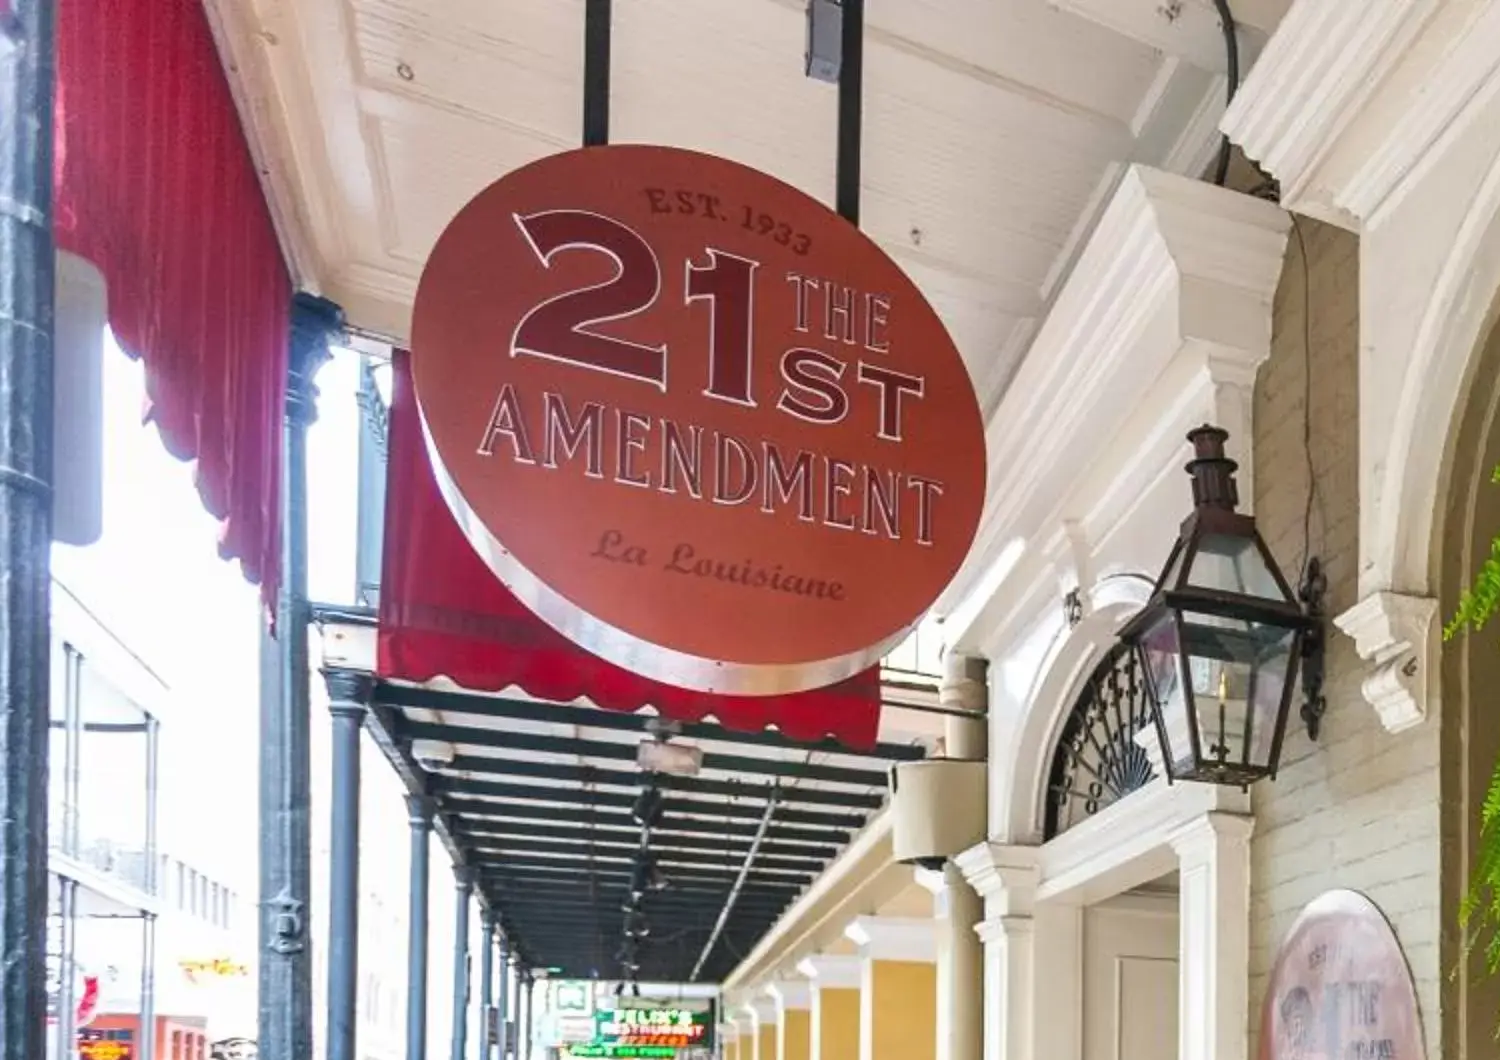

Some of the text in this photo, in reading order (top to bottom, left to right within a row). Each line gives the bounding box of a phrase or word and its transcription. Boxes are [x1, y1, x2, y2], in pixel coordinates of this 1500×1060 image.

[644, 188, 813, 257] EST. 1933
[785, 271, 891, 354] THE
[476, 382, 943, 547] AMENDMENT
[591, 528, 847, 602] La Louisiane
